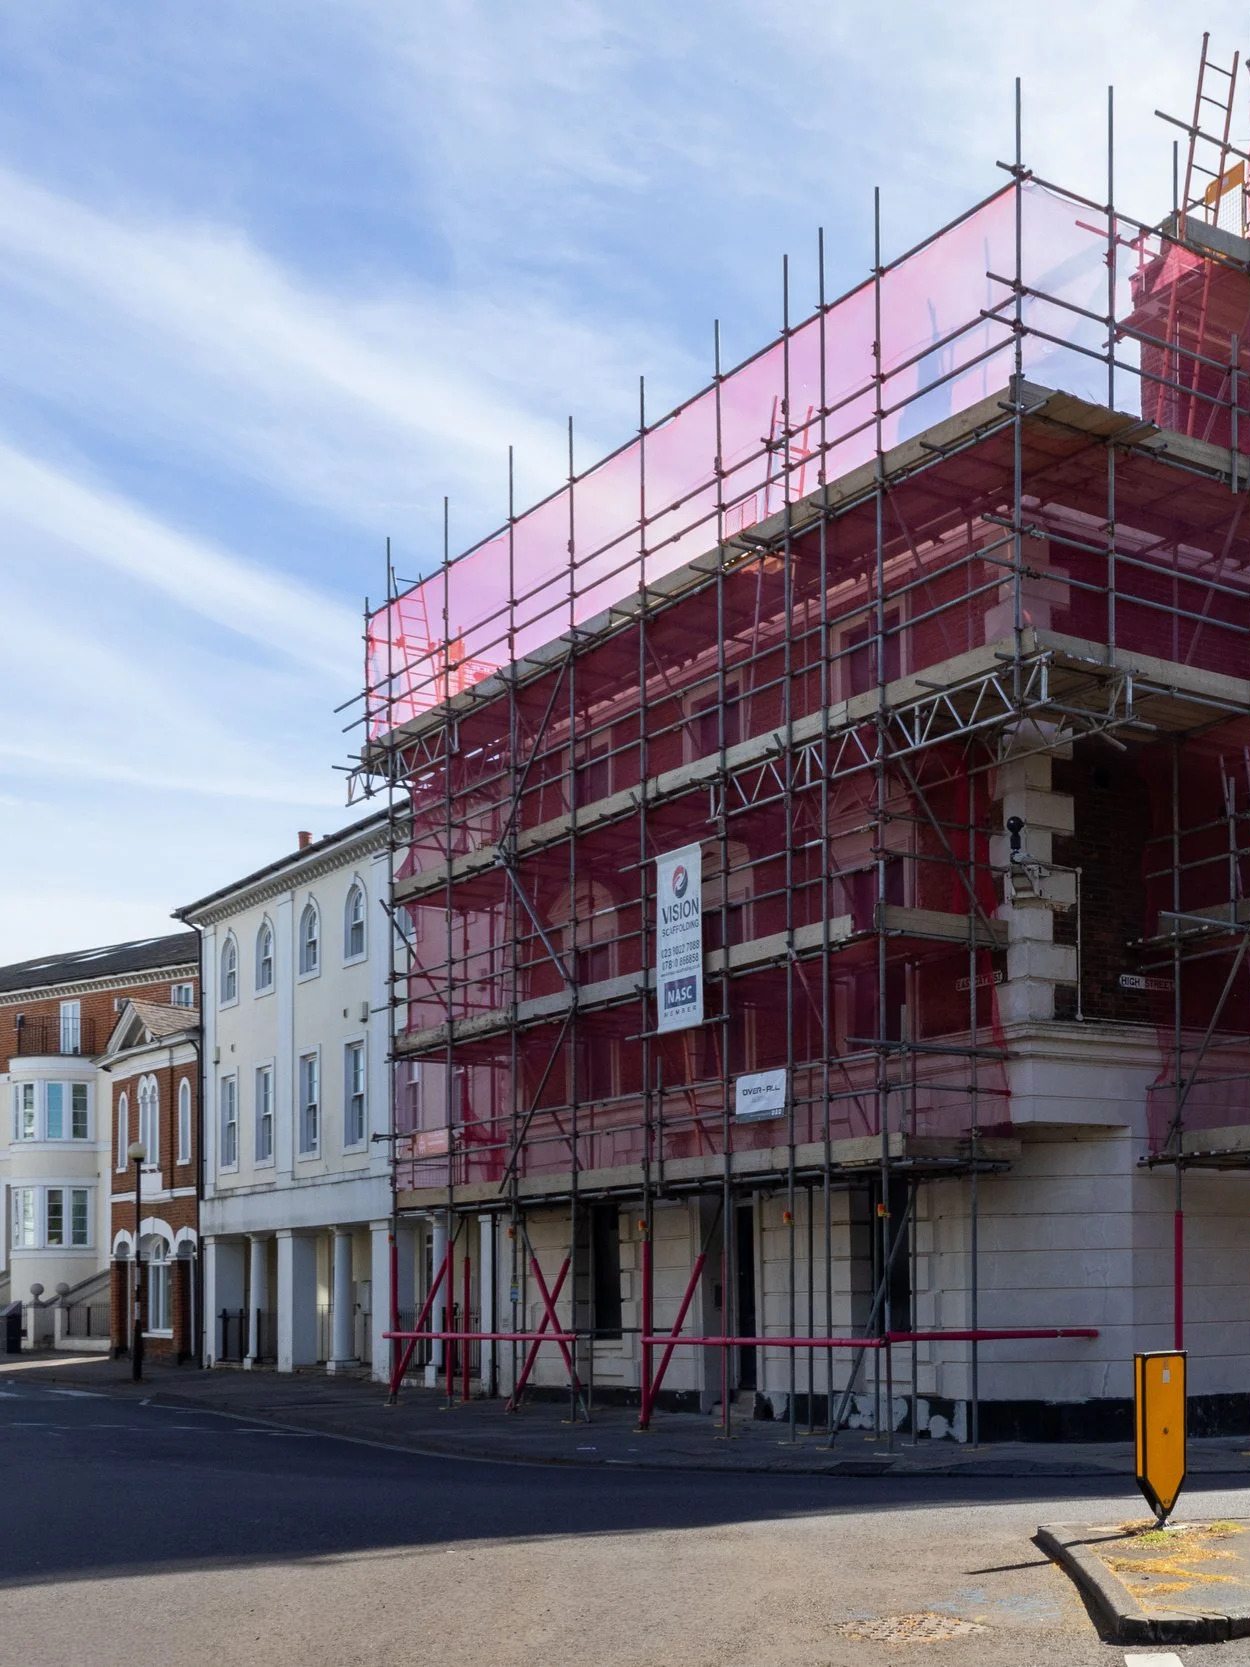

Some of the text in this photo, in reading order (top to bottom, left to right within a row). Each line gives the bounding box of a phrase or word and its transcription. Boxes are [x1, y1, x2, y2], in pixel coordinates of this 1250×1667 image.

[662, 897, 699, 924] VISION
[662, 919, 700, 937] SCAFFOLDING
[1121, 976, 1139, 986] HIGH
[668, 985, 692, 1004] NASC
[664, 1005, 697, 1017] MEMBER
